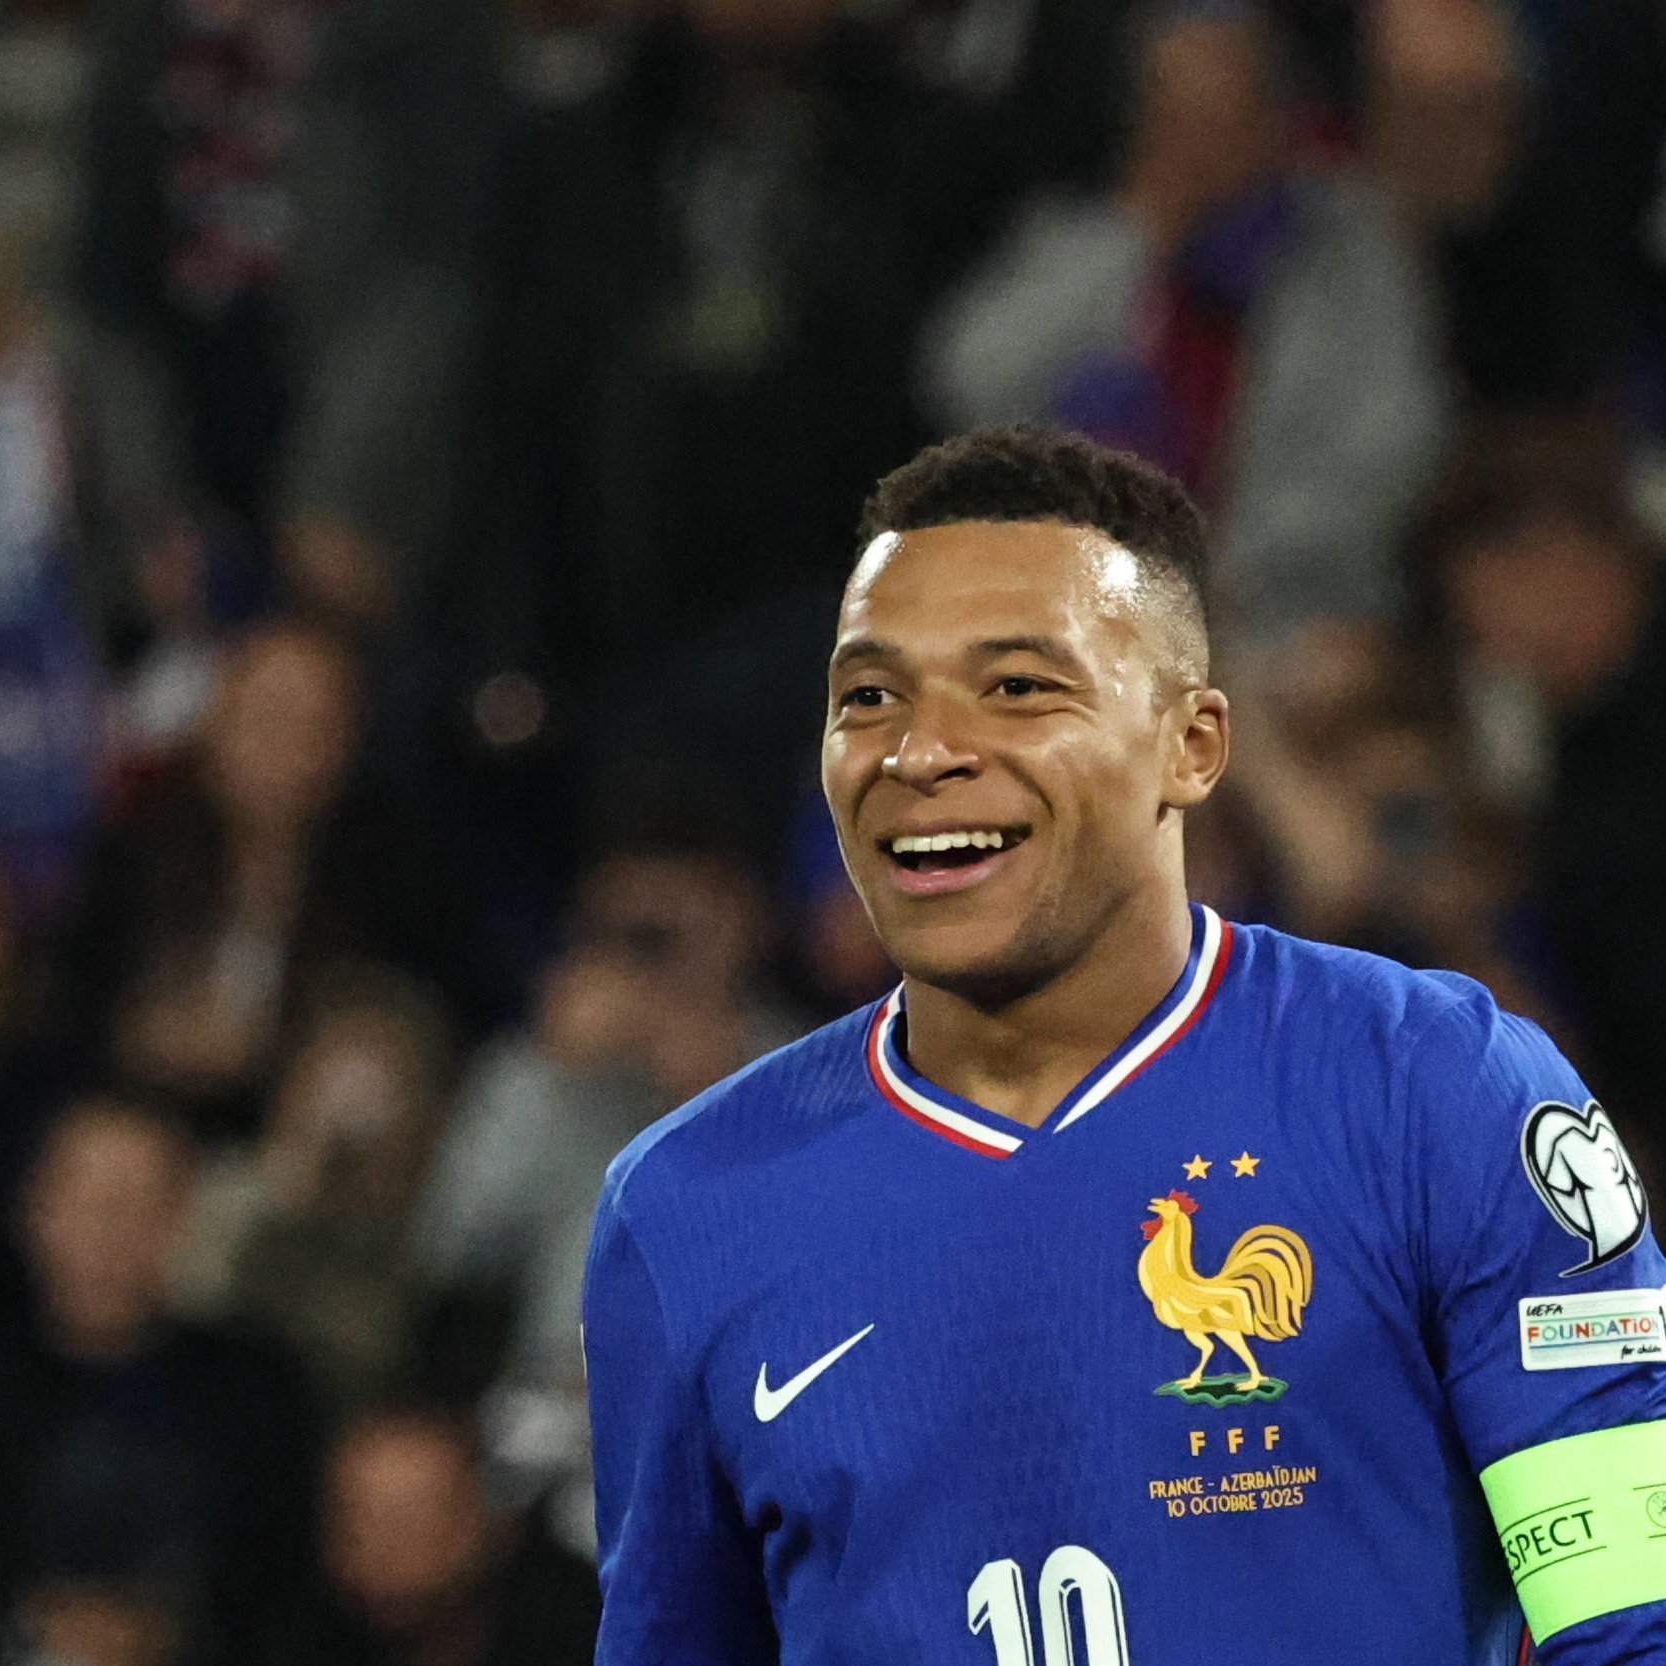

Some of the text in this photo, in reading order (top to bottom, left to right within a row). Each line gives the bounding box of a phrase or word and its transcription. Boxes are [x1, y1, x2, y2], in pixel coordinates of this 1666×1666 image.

[1526, 1303, 1563, 1317] UEFA
[1149, 1477, 1204, 1500] FRANCE
[1220, 1465, 1317, 1493] AZERBAÏDJAN
[1167, 1487, 1304, 1518] 10 OCTOBRE 2025
[1502, 1510, 1594, 1577] SPECT
